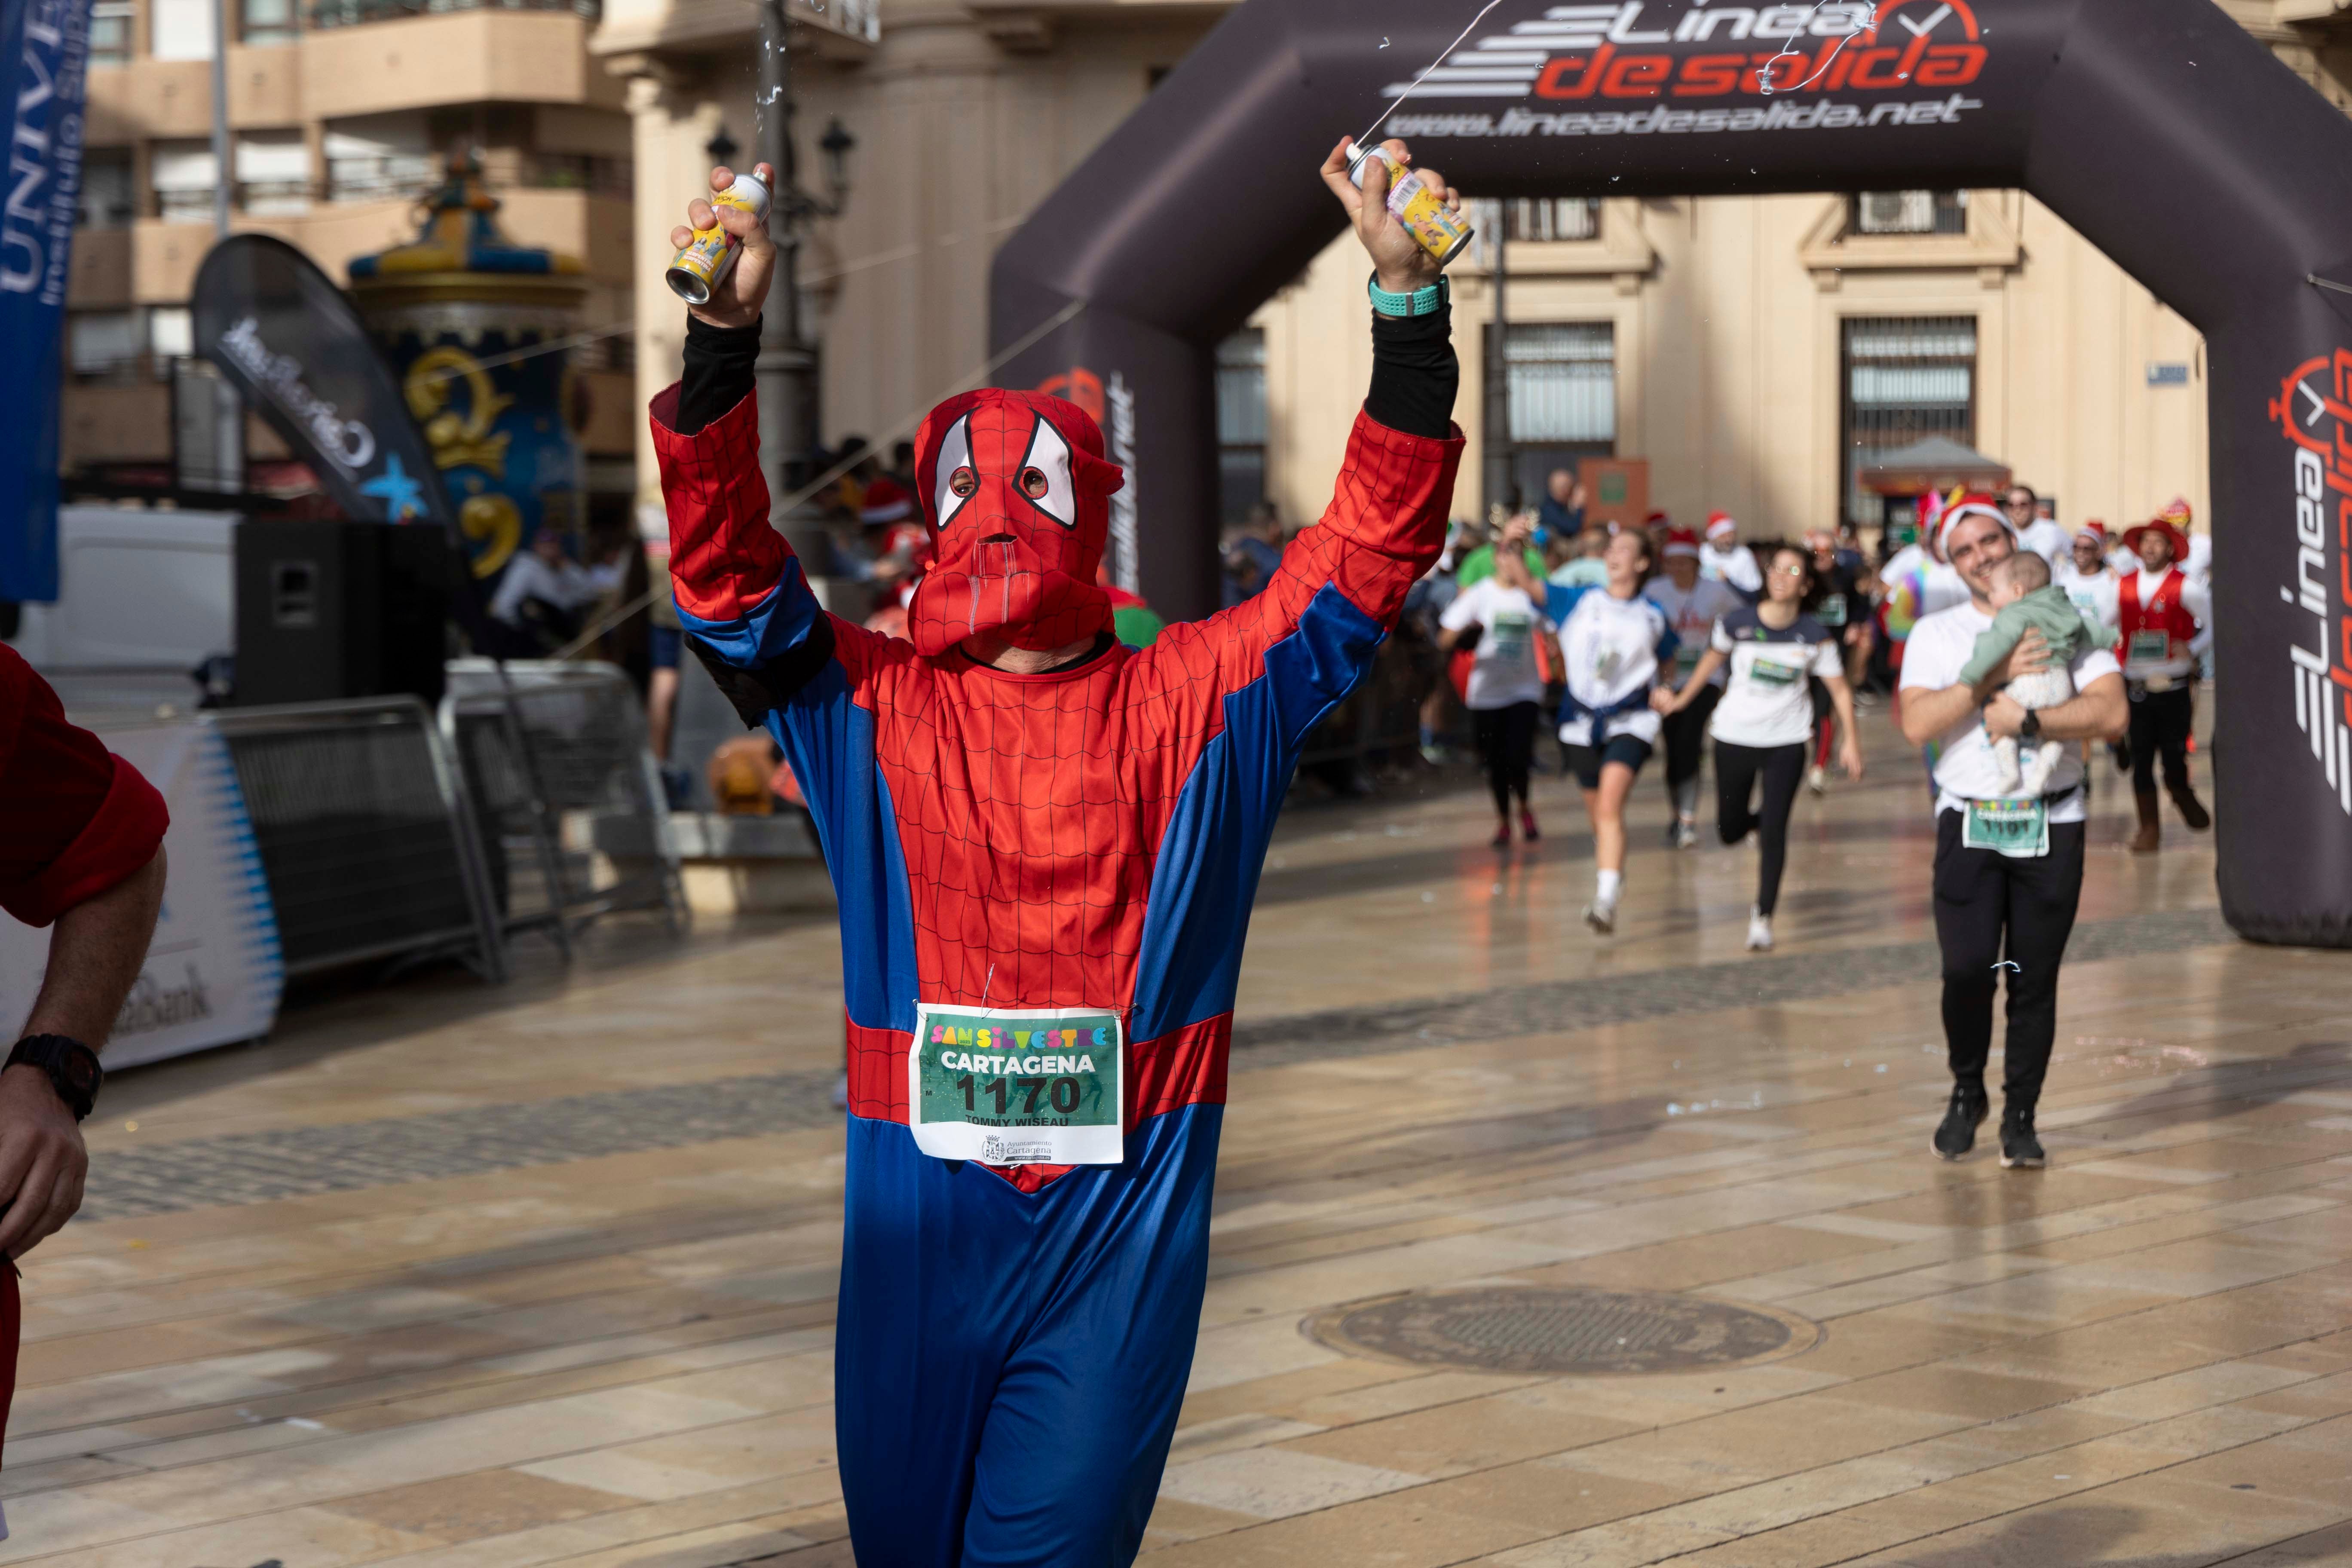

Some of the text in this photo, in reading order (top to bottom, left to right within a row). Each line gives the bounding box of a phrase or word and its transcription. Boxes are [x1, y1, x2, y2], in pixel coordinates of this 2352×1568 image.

[931, 1025, 973, 1046] SAN
[941, 1051, 1096, 1075] CARTAGENA
[957, 1075, 1081, 1114] 1170
[965, 1115, 1069, 1127] TOMMY WISEAU
[1007, 1146, 1051, 1155] Cartagena
